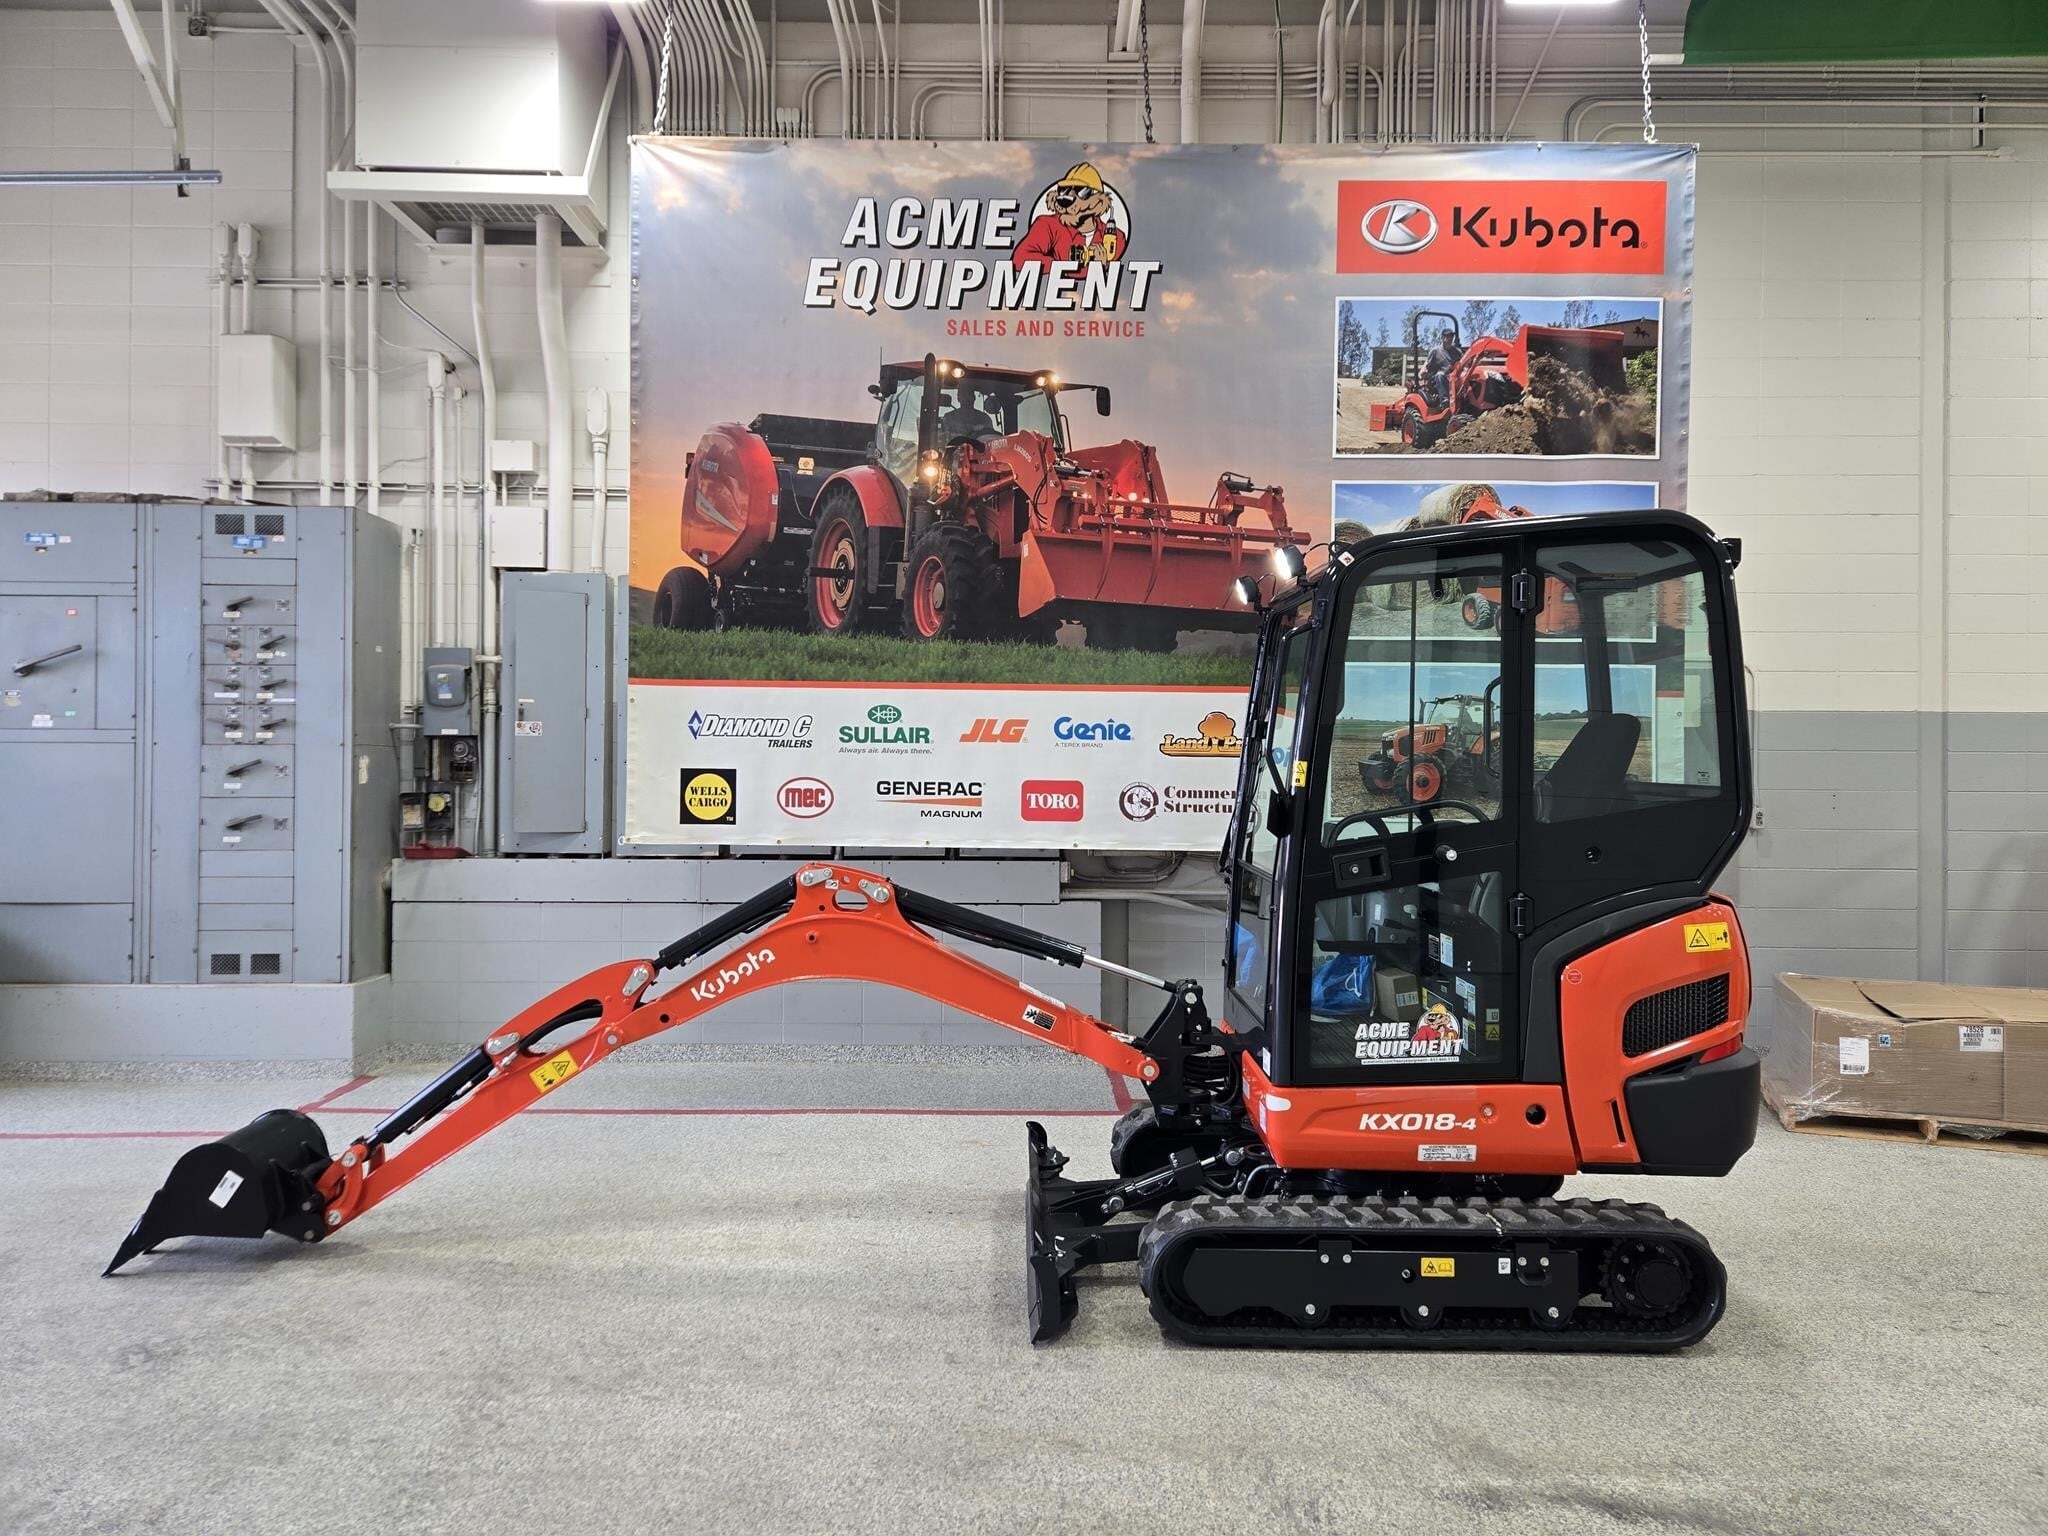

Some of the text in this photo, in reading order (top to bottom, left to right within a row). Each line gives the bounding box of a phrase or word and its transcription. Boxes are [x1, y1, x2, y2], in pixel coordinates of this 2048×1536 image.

[841, 196, 1020, 249] ACME
[1452, 206, 1640, 249] Kubota
[803, 256, 1163, 316] EQUIPMENT
[946, 319, 1145, 338] SALES AND SERVICE
[699, 714, 813, 738] DIAMOND C
[838, 726, 930, 744] SULLAIR
[959, 718, 1030, 743] JLG
[1053, 716, 1132, 741] Genie
[768, 739, 813, 748] TRAILERS
[838, 747, 865, 755] Always
[881, 747, 908, 755] Always
[690, 786, 728, 796] WELLS
[876, 781, 983, 797] GENERAC
[688, 797, 728, 807] CARGO
[1026, 793, 1079, 809] TORO
[920, 810, 983, 819] MAGNUM
[689, 947, 777, 1002] Kubota
[1354, 1021, 1411, 1041] ACME
[1354, 1038, 1465, 1059] EQUIPMENT
[1359, 1112, 1477, 1132] KX018-4
